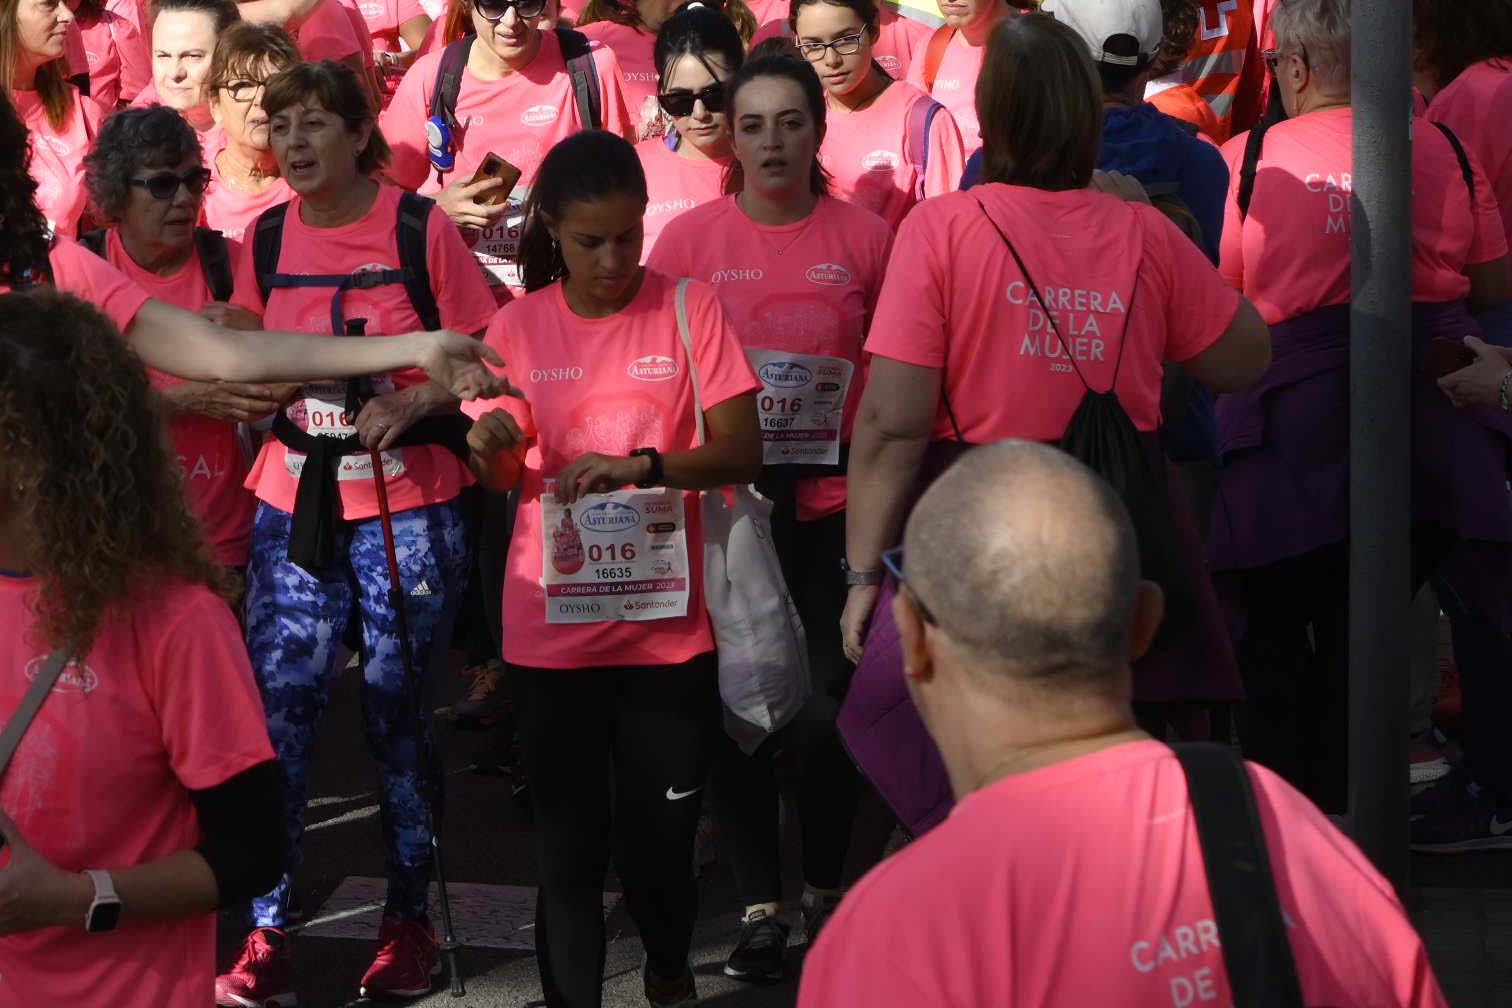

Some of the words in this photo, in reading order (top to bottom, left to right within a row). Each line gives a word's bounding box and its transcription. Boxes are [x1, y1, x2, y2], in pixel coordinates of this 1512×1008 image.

[646, 198, 695, 217] OYSHO
[711, 267, 764, 284] OYSHO
[1006, 281, 1126, 313] CARRERA
[1029, 308, 1061, 333] DE
[1068, 312, 1101, 336] LA
[1019, 333, 1105, 361] MUJER
[530, 365, 584, 382] OYSHO
[630, 362, 678, 376] ASTURIANA
[763, 369, 808, 382] ASTURIANA
[760, 394, 803, 413] 016
[311, 410, 349, 427] 016
[763, 417, 794, 428] 16637
[582, 514, 636, 526] ASTURIANA
[588, 542, 636, 562] 016
[595, 567, 632, 580] 16635
[560, 586, 598, 595] CARRERA
[599, 585, 611, 593] DE
[624, 583, 653, 592] MUJER
[559, 603, 601, 614] OYSHO
[634, 599, 679, 610] Santander
[1169, 966, 1219, 1008] DE
